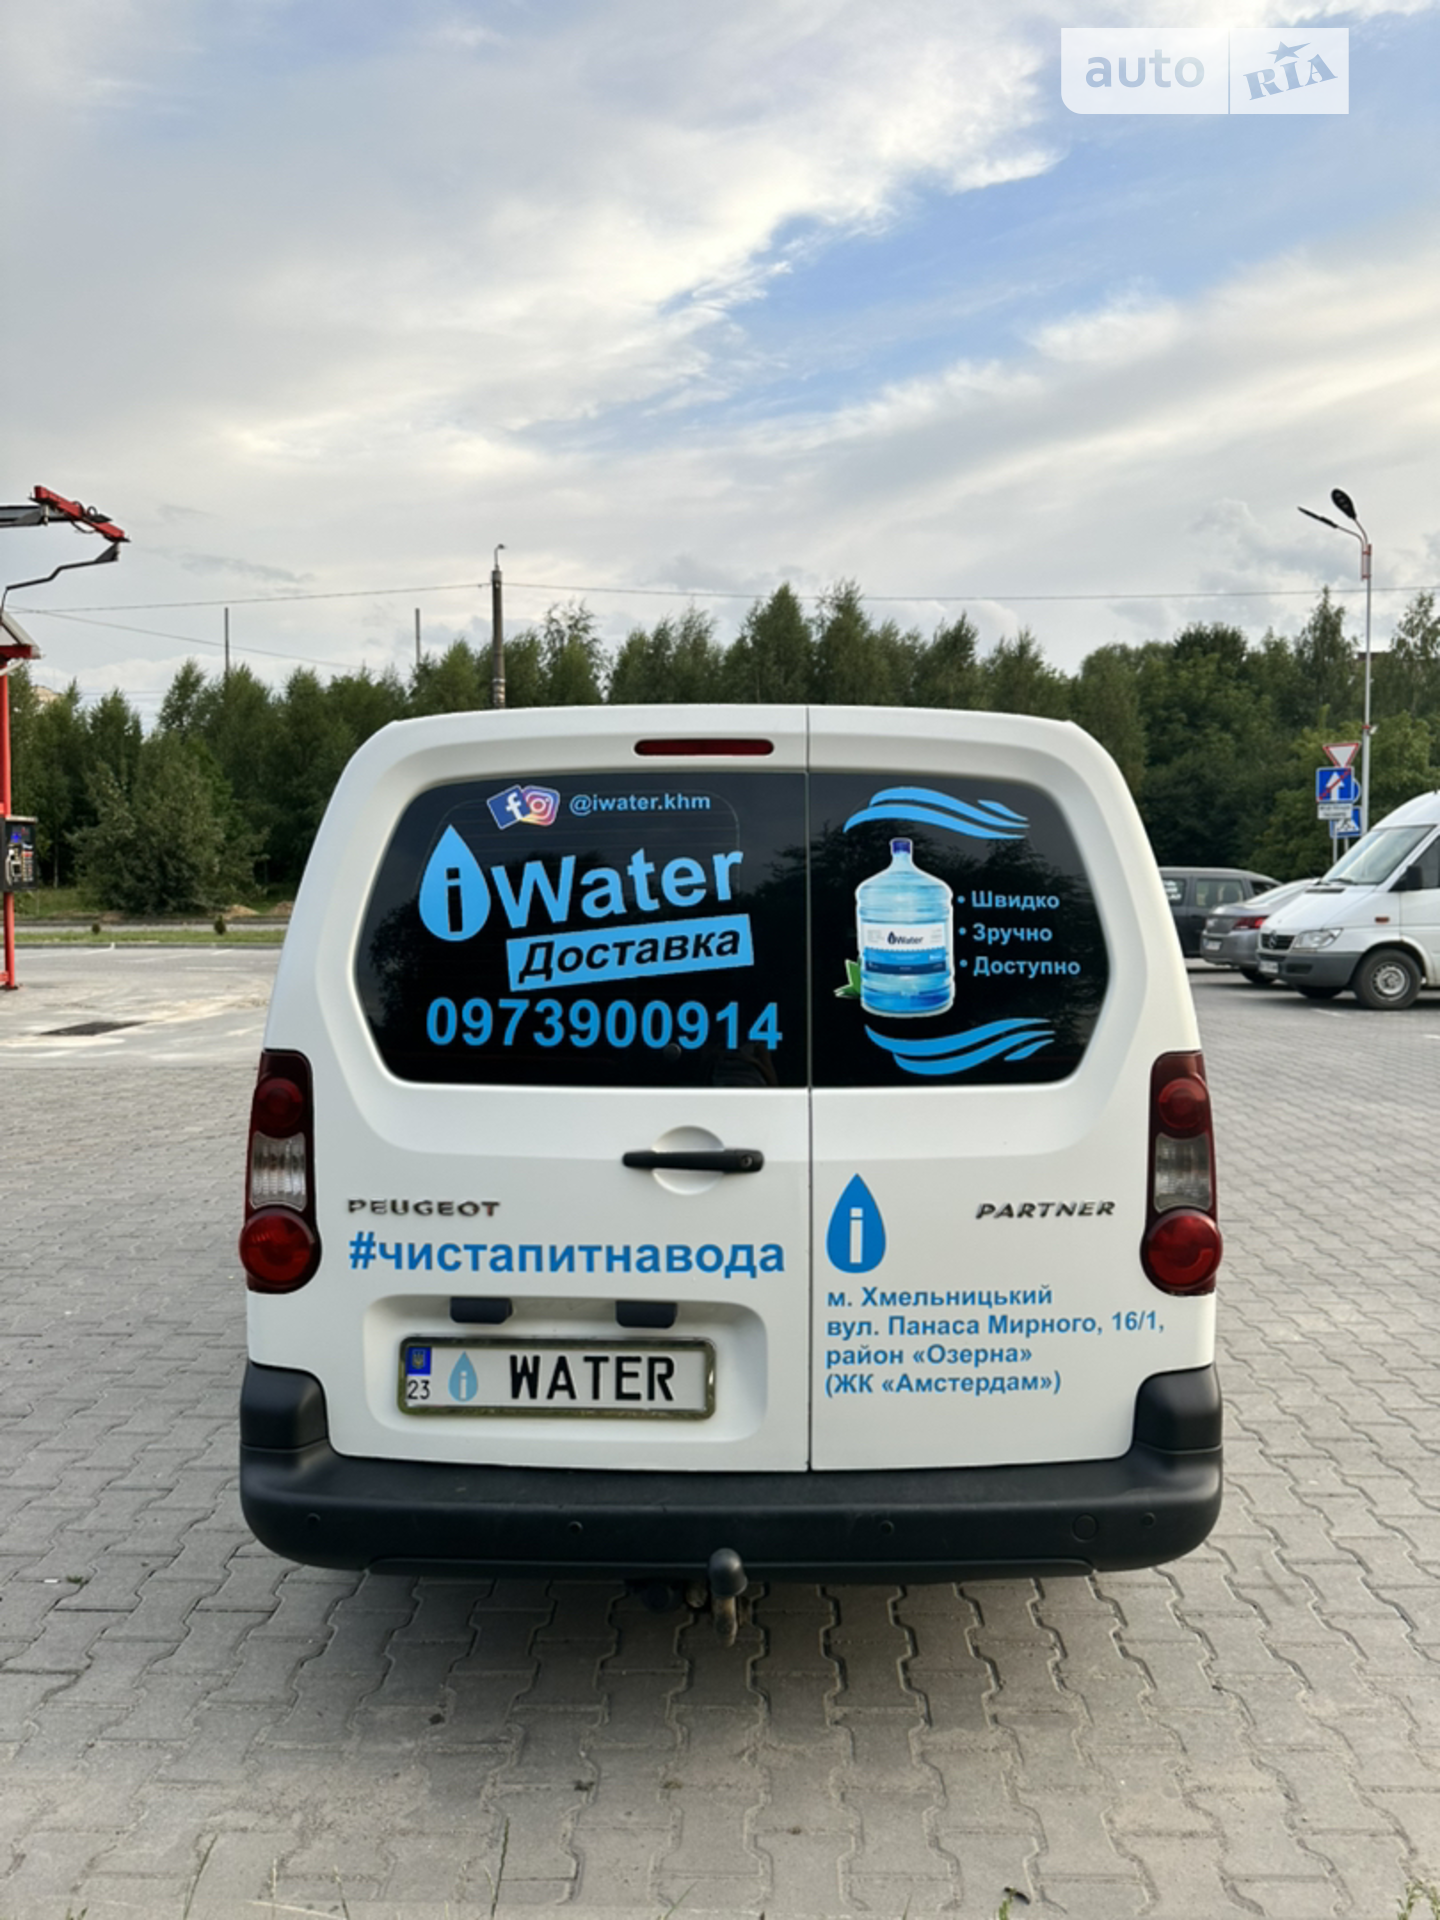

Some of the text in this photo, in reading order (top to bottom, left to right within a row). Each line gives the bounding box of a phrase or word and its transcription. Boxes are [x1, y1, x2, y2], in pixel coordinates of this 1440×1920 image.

[568, 793, 711, 816] @iwater.khm
[971, 890, 1060, 911] Швидко
[972, 923, 1053, 944] Зручно
[517, 928, 741, 984] Доставка
[972, 955, 1081, 978] Доступно
[426, 996, 783, 1051] 0973900914
[348, 1199, 500, 1217] PEUGEOT
[975, 1201, 1116, 1220] PARTNER
[348, 1230, 785, 1279] #чистапитнавода
[827, 1284, 1053, 1308] м. Хмельницький
[826, 1310, 1166, 1341] вул. Панаса Мирного, 16/1,
[825, 1343, 1033, 1369] район «Озерна»
[406, 1379, 431, 1400] 23
[509, 1354, 676, 1402] WATER
[825, 1371, 1061, 1397] (ЖК «Амстердам»)
